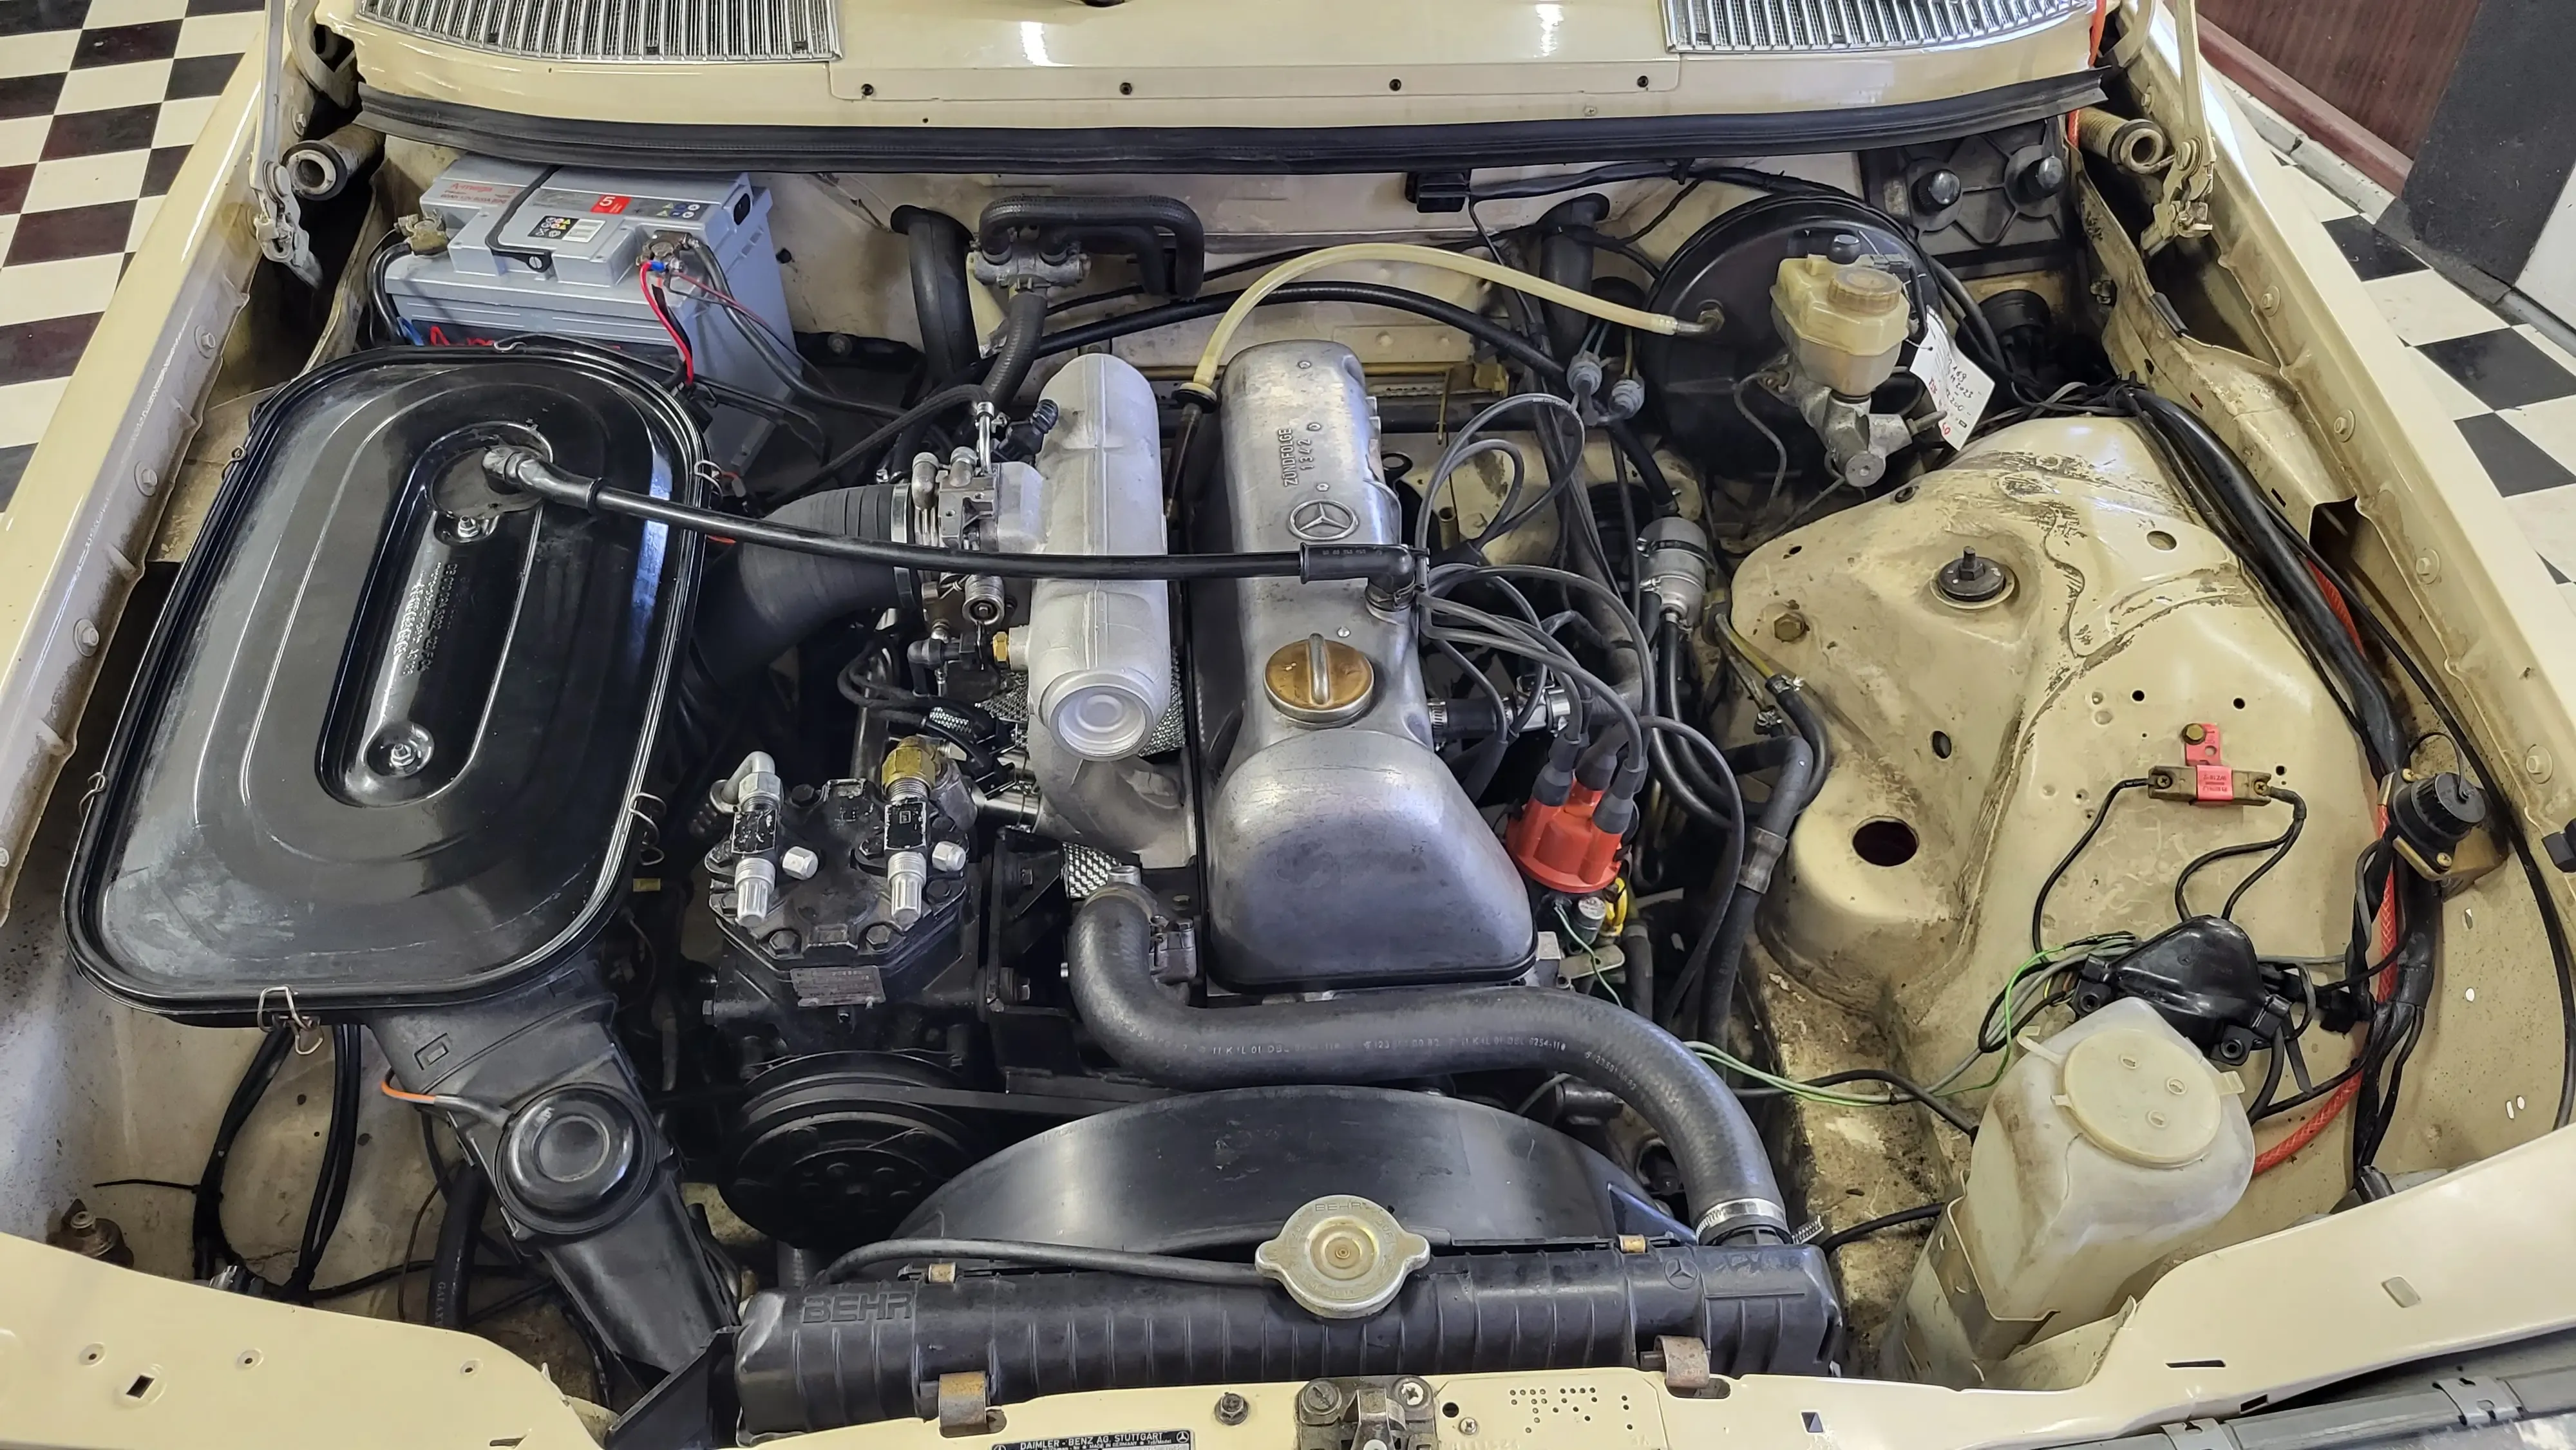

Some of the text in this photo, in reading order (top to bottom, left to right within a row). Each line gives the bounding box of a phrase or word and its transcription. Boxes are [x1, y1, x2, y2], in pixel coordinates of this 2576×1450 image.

[599, 196, 615, 207] 5
[1278, 428, 1299, 487] ZÜNDFOLGE
[1315, 1201, 1363, 1211] BEHR
[802, 1292, 913, 1324] BEHR
[1020, 1440, 1059, 1450] DAIMLER
[1068, 1436, 1094, 1446] BENZ
[1114, 1432, 1162, 1443] STUTTGART
